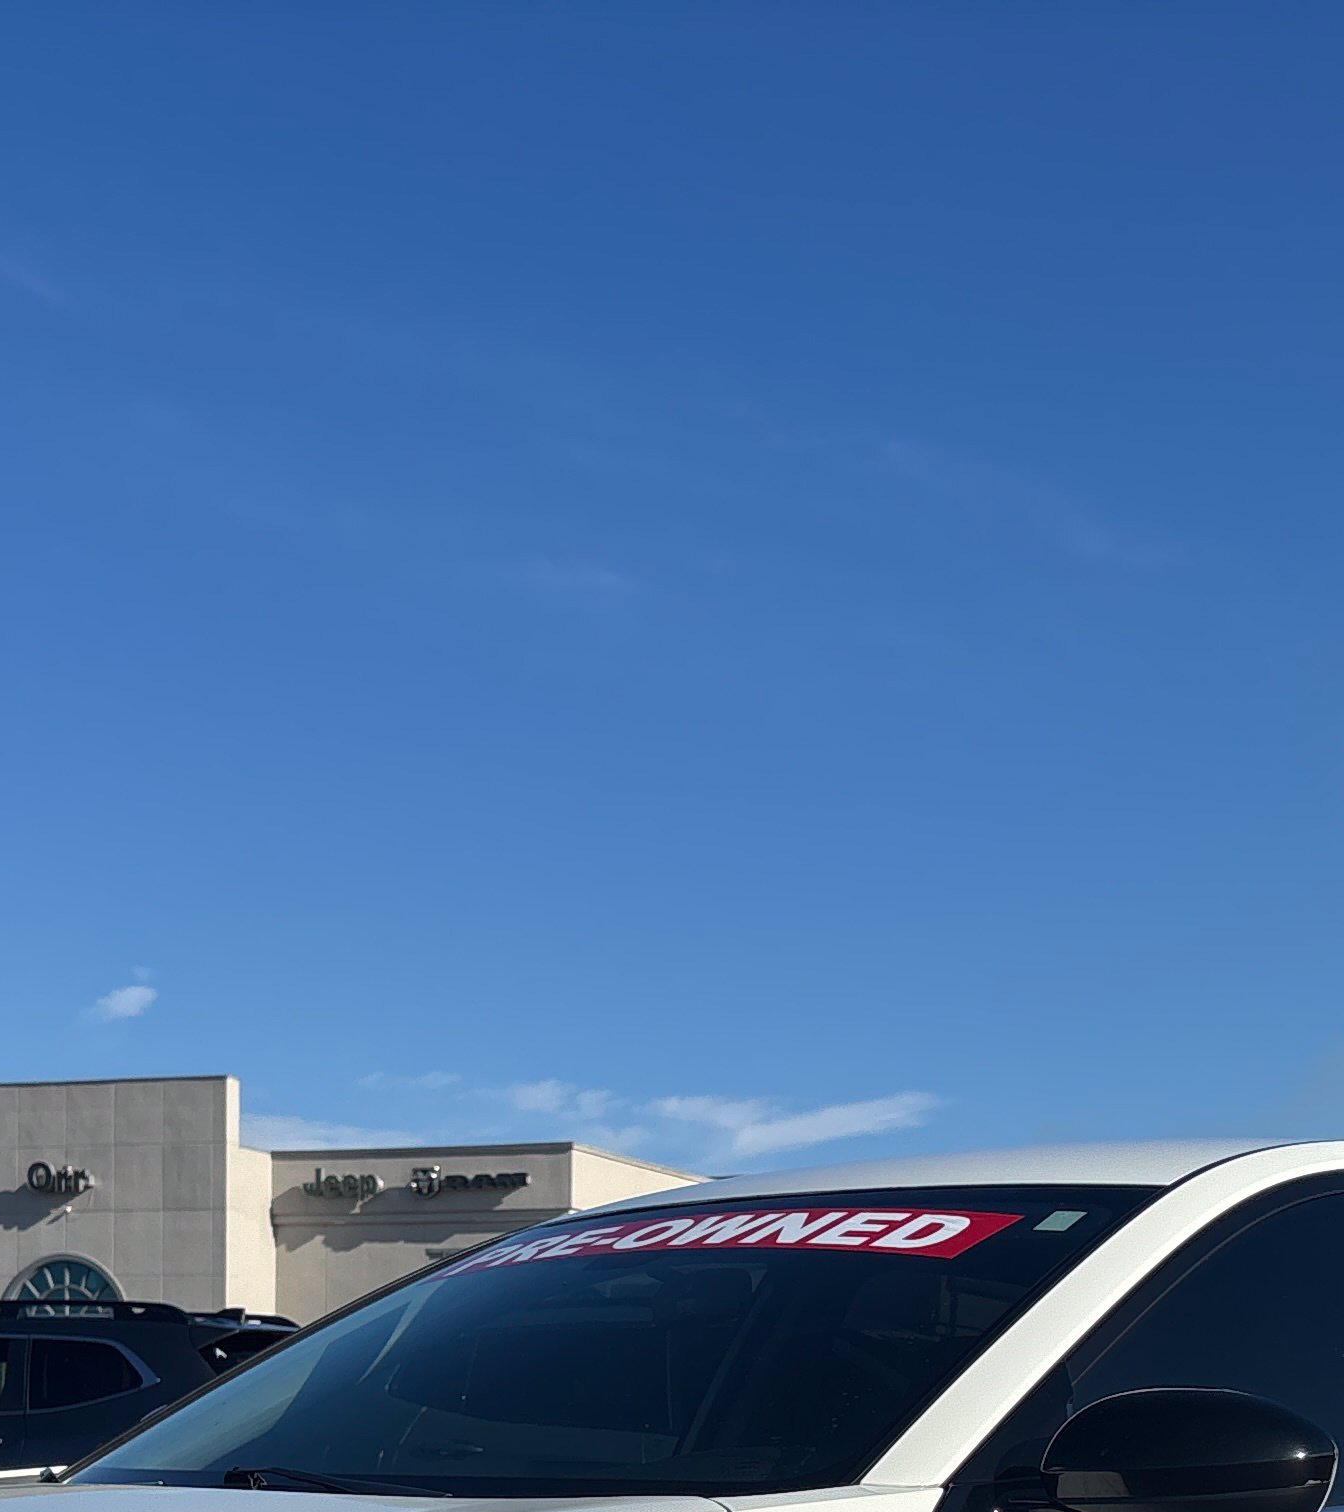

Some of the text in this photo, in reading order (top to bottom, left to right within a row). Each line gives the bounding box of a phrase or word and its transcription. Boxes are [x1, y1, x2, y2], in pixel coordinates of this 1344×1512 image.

[27, 1161, 94, 1193] Orr
[302, 1166, 380, 1200] Jeep
[443, 1211, 971, 1278] PRE-OWNED
